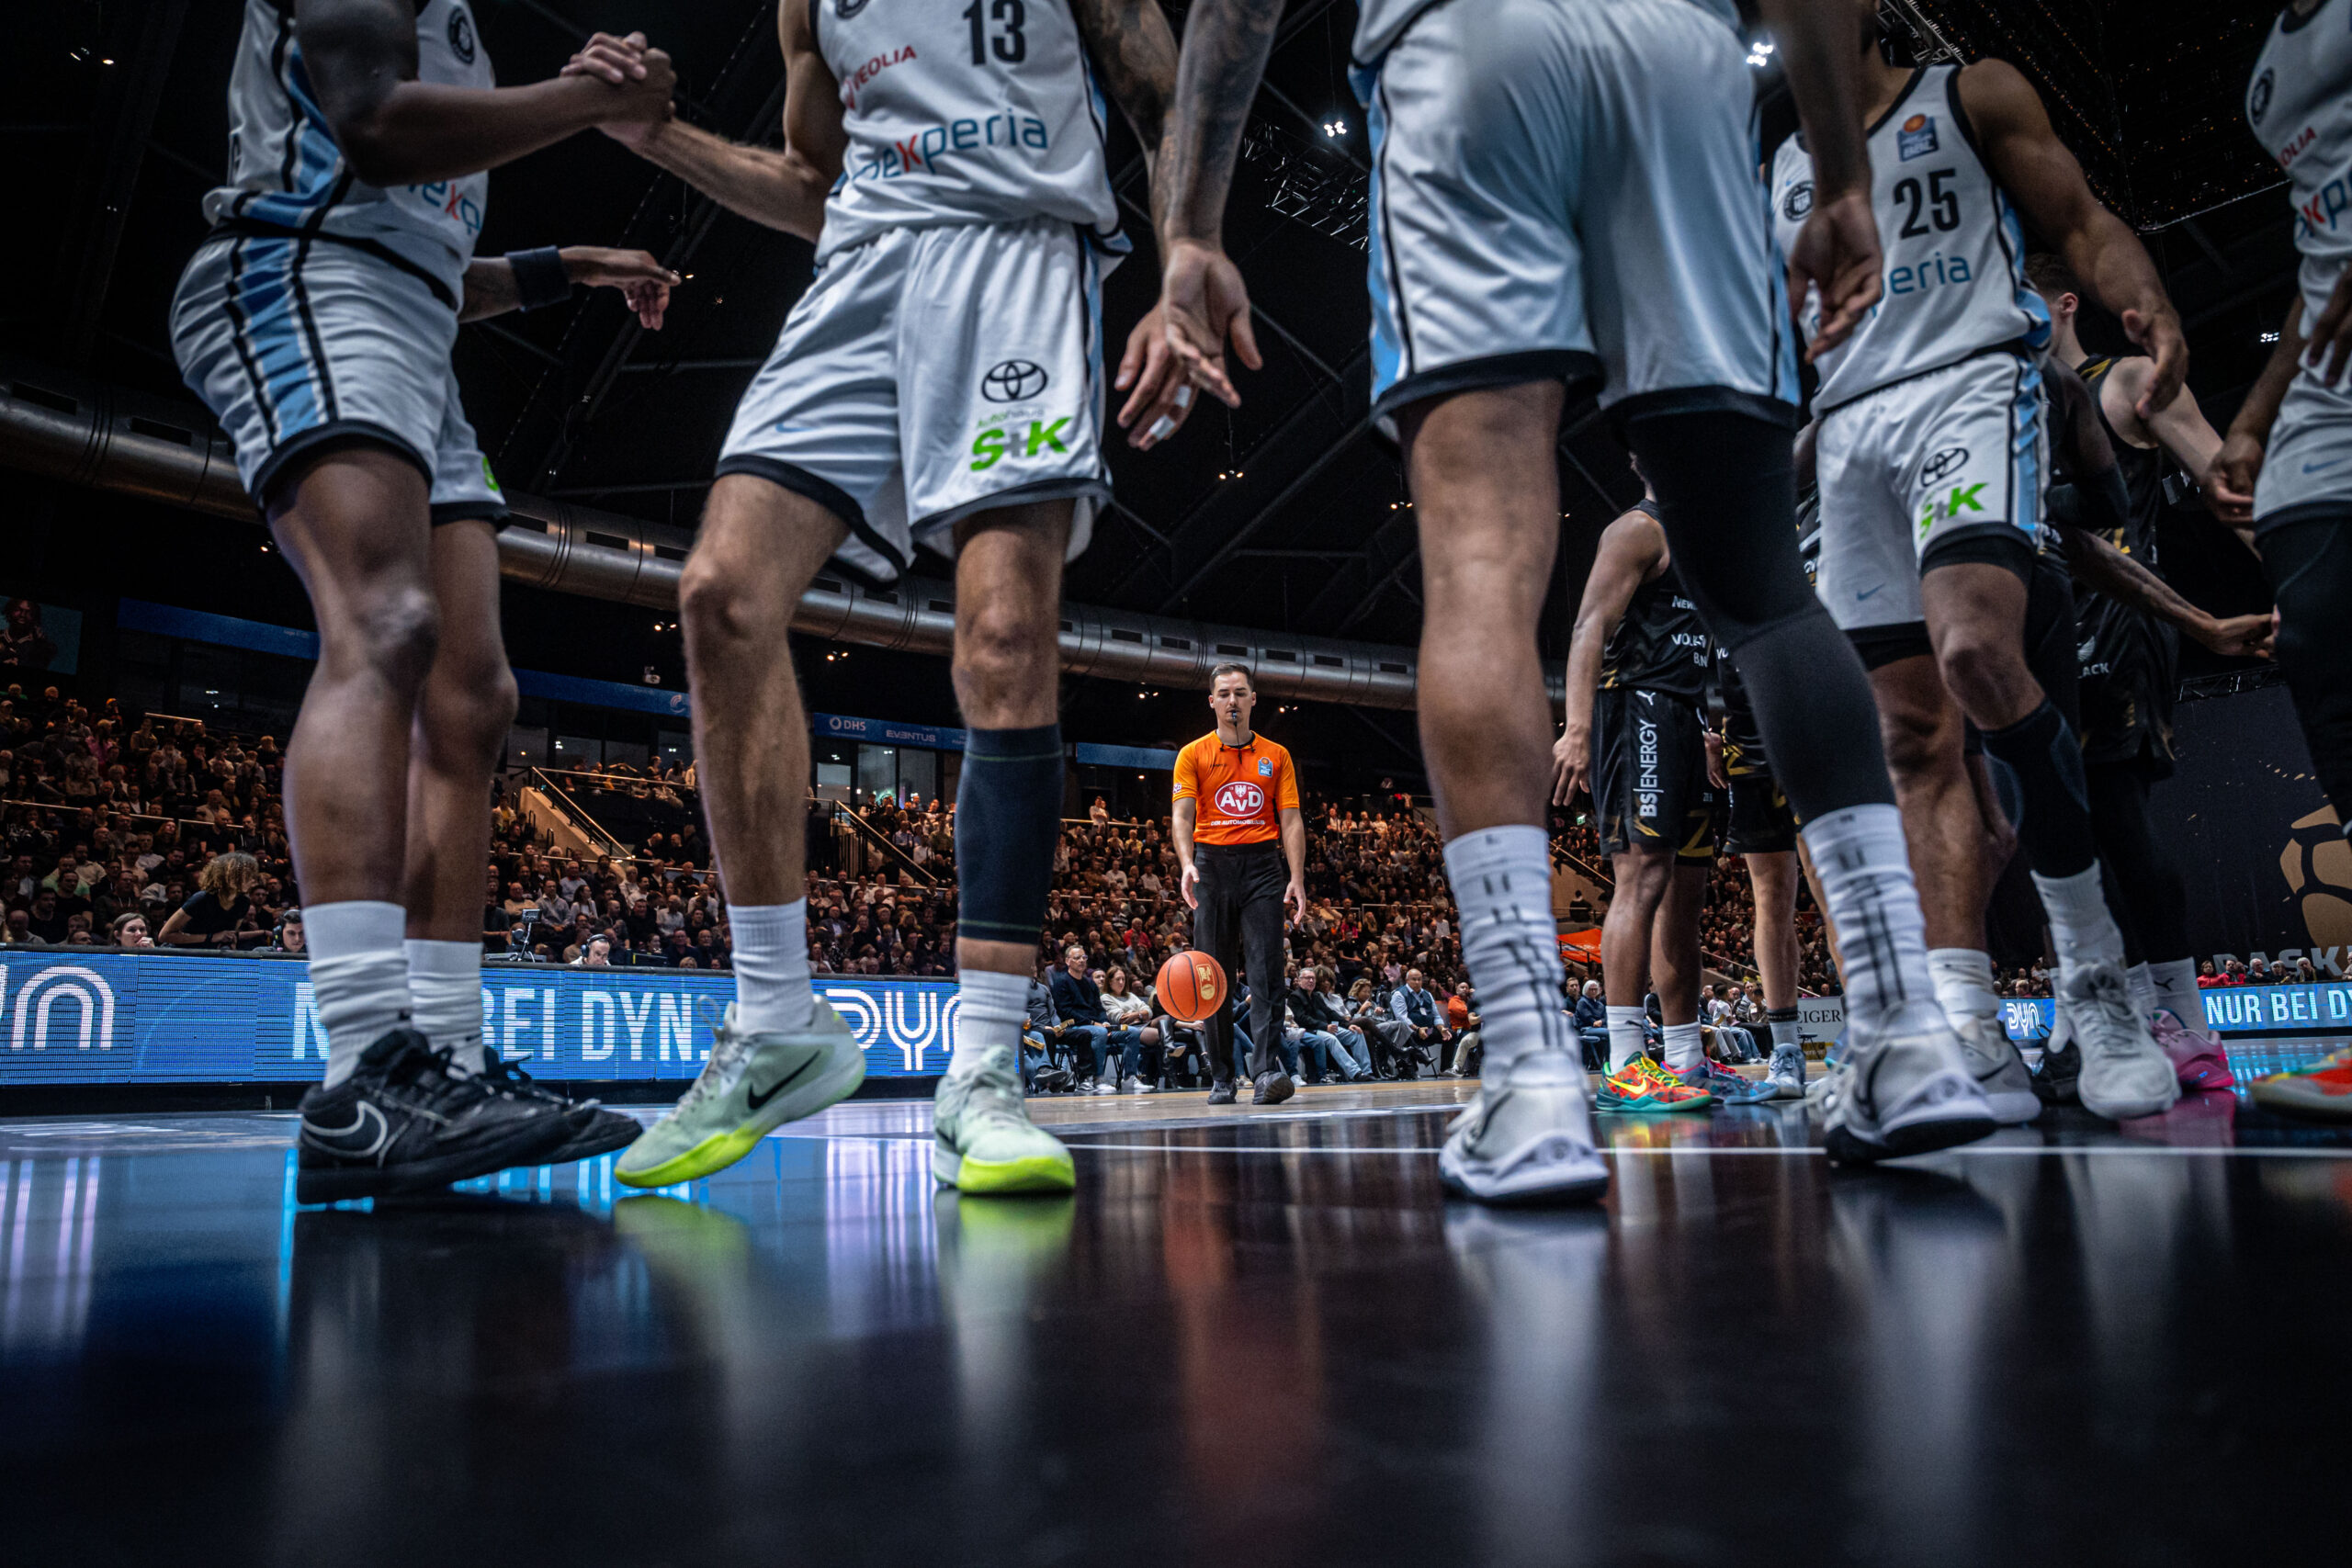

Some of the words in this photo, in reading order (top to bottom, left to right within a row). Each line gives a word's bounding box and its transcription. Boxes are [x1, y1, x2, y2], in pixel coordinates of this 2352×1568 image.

[962, 0, 1026, 66] 13
[2277, 126, 2317, 167] OLIA
[1893, 168, 1961, 240] 25
[970, 416, 1073, 471] S+K
[2077, 662, 2110, 679] ACK
[843, 720, 866, 731] DHS
[886, 729, 937, 743] EVENTUS
[2205, 993, 2263, 1025] NUR
[2270, 990, 2319, 1021] BEI
